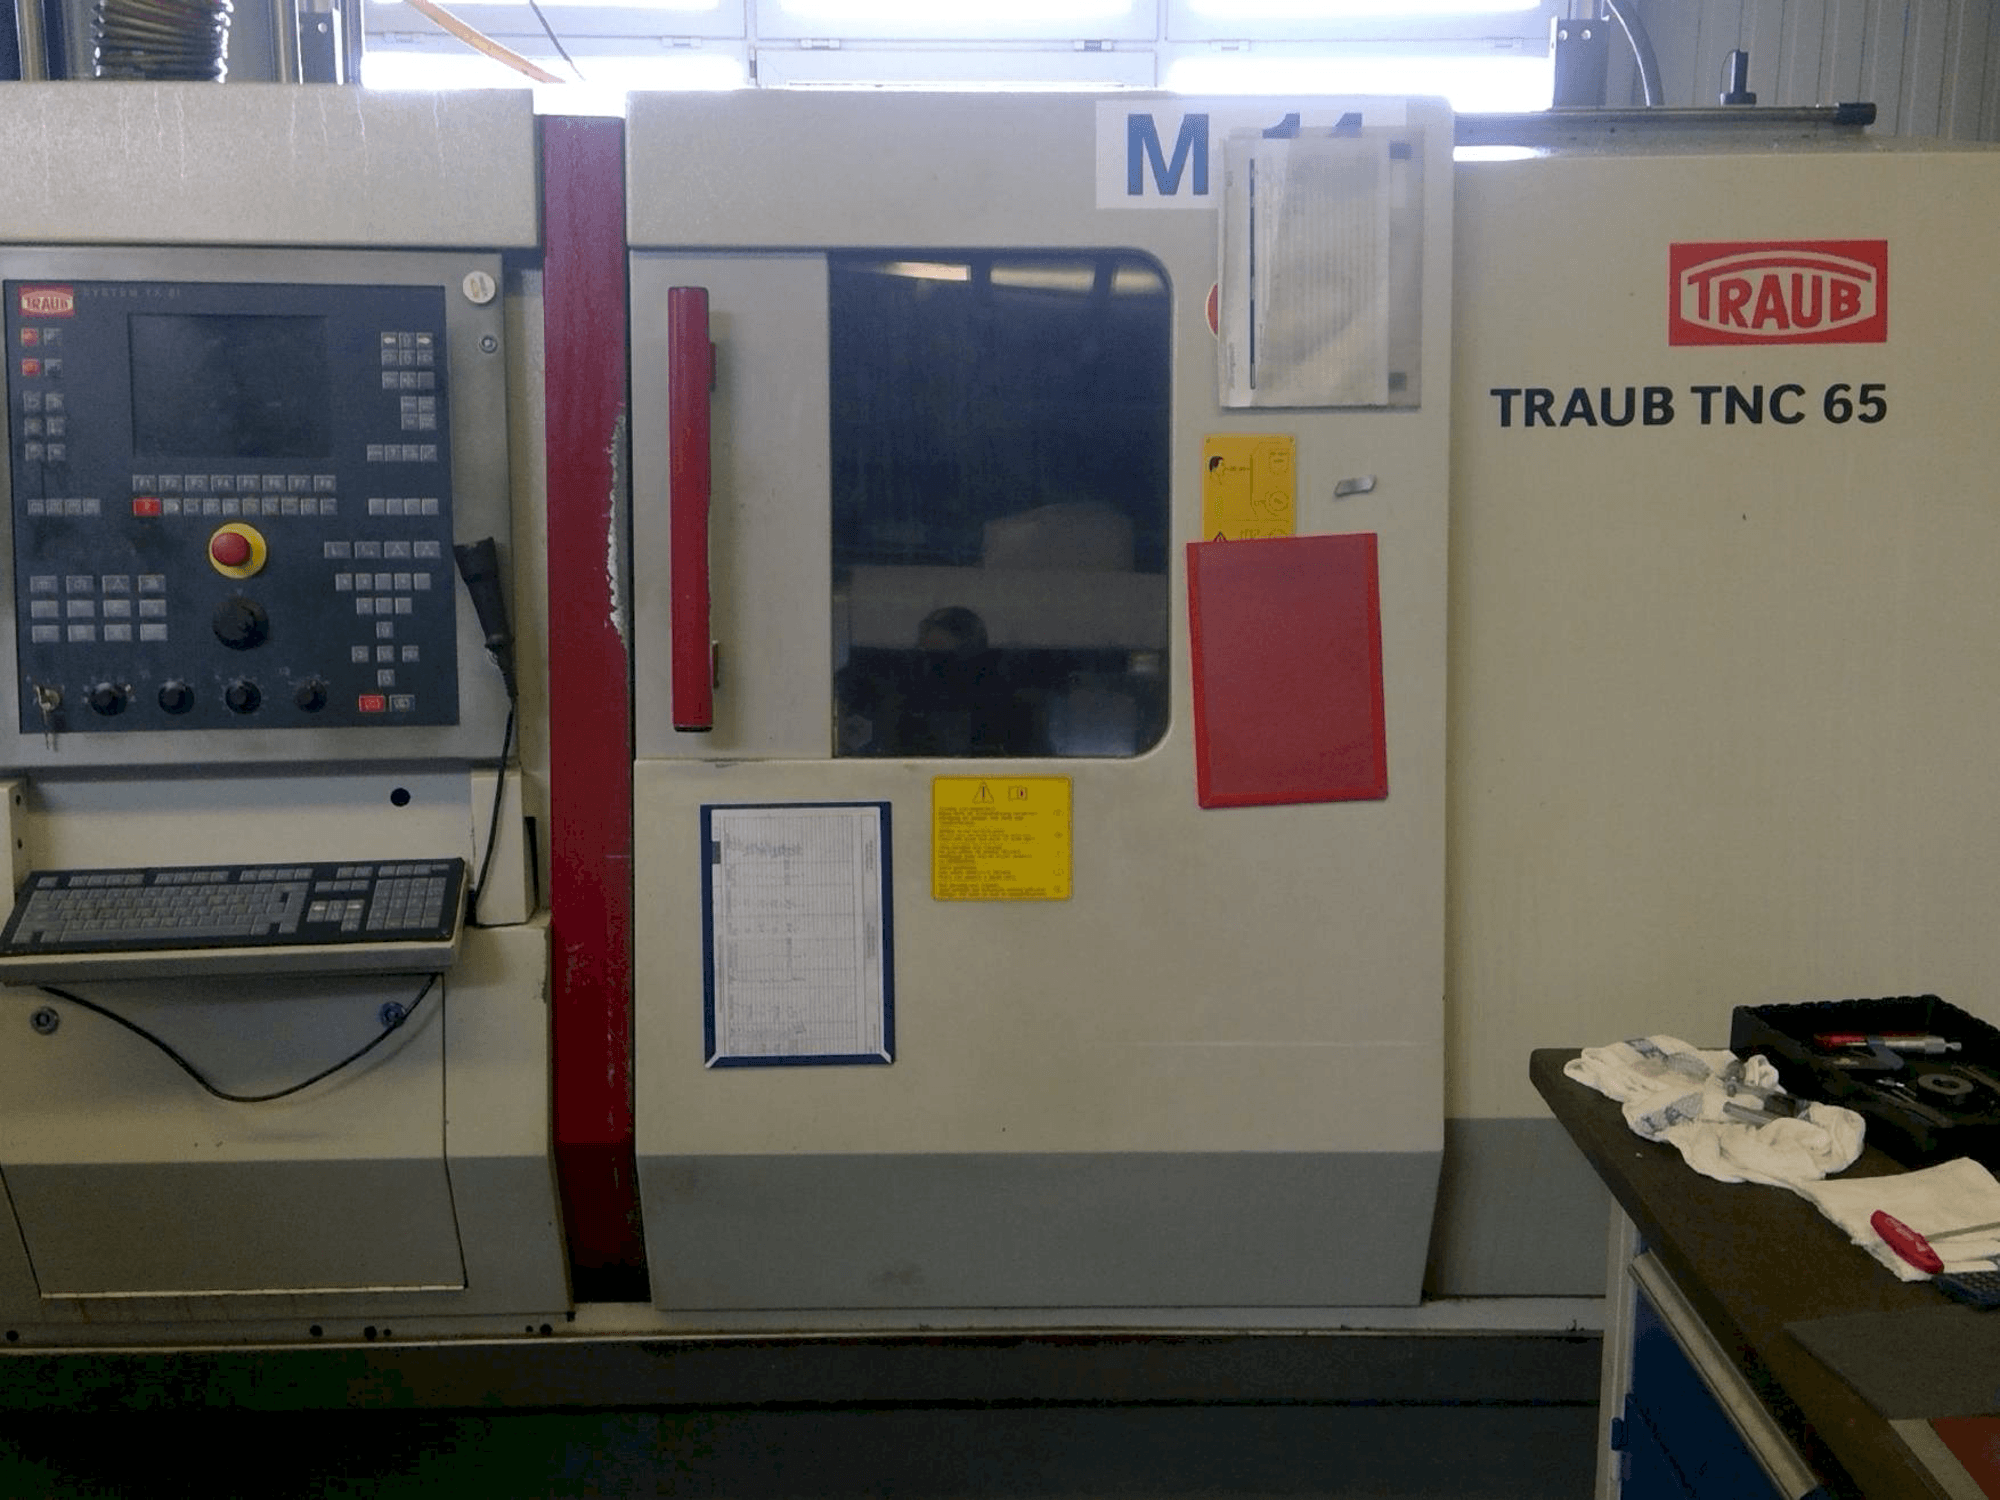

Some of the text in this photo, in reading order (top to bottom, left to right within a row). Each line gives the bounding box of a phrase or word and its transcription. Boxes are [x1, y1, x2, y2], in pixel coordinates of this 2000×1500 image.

[1127, 113, 1209, 195] M
[1686, 257, 1873, 330] TRAUB
[1490, 383, 1888, 427] TRAUB TNC 65
